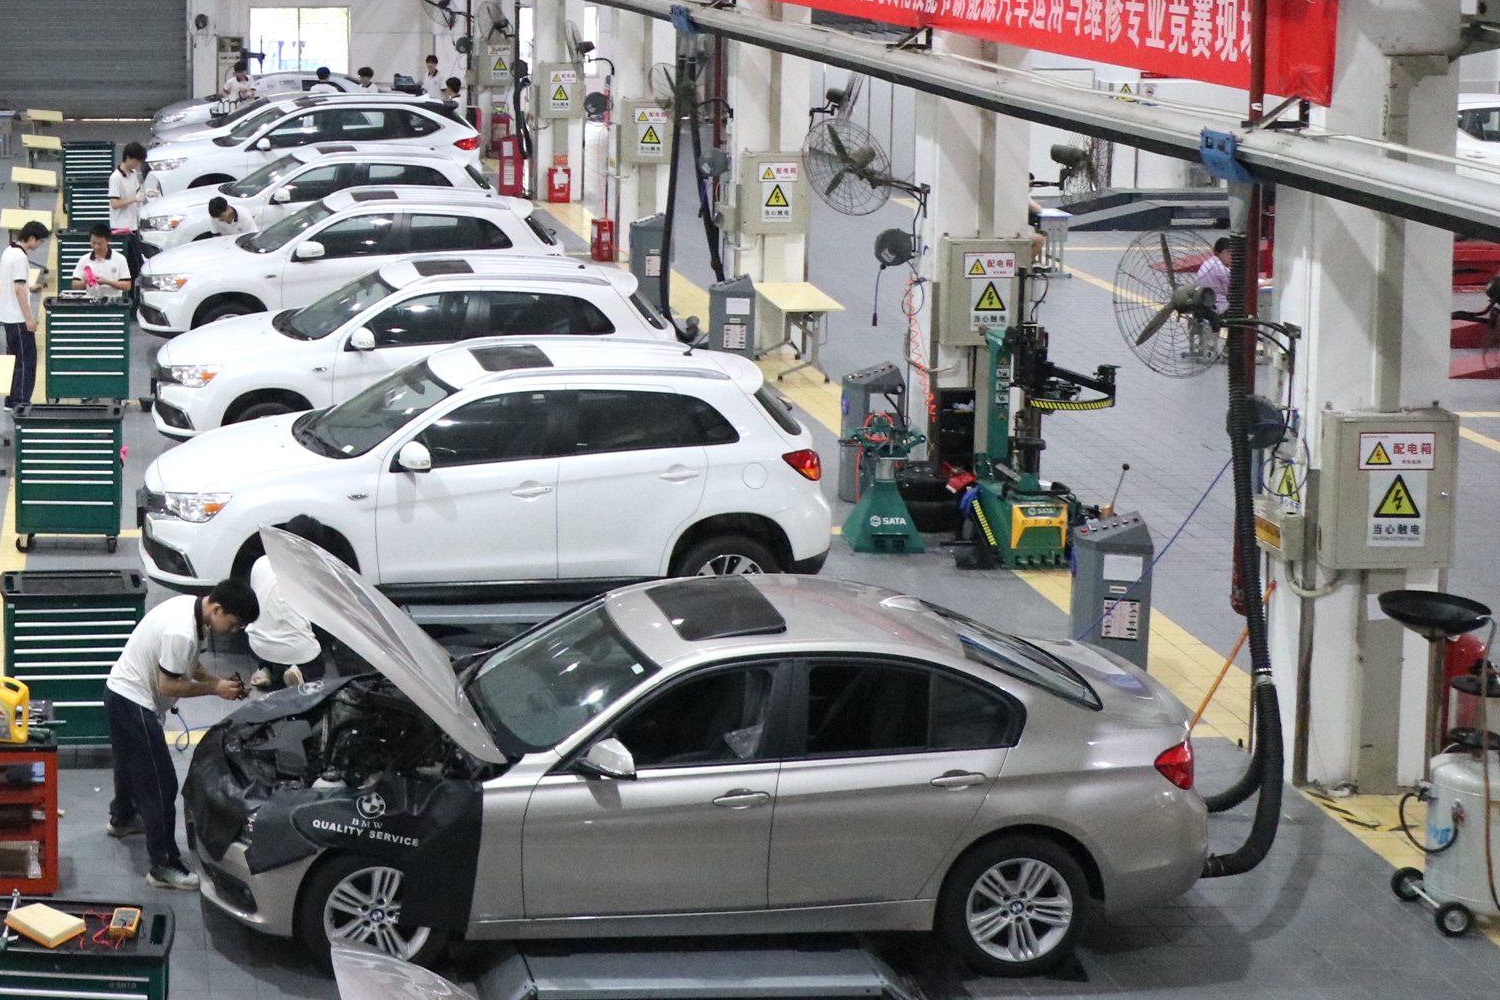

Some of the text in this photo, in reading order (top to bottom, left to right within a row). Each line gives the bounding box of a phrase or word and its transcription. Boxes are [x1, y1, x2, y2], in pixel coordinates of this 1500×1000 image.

[987, 259, 1014, 268] 配电箱
[1393, 442, 1433, 455] 配电箱
[882, 517, 907, 526] SATA
[1373, 523, 1421, 536] 当心触电
[351, 818, 384, 830] BMW
[312, 819, 419, 847] QUALITY SERVICE
